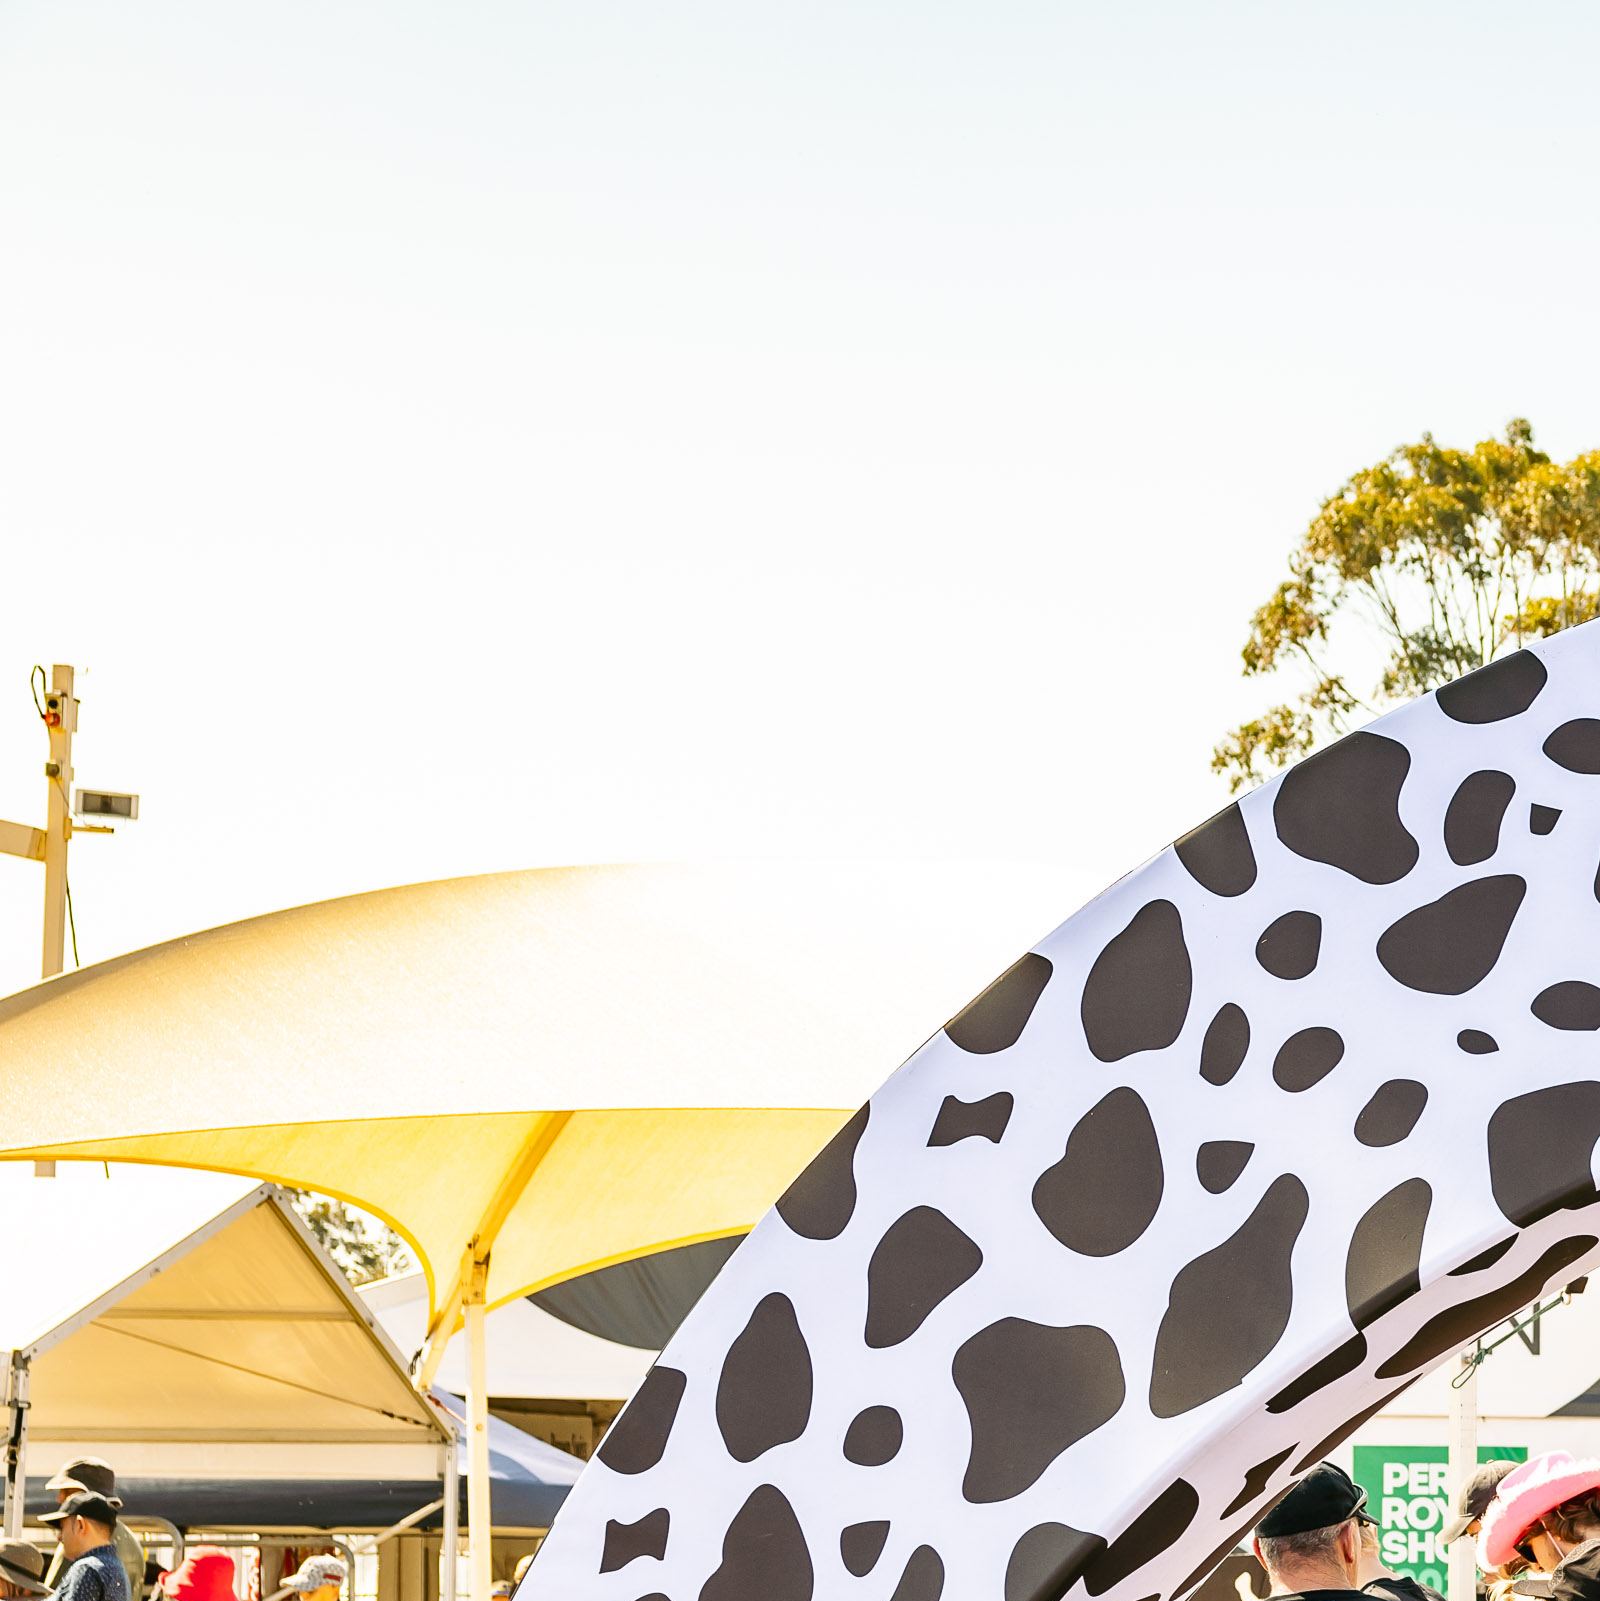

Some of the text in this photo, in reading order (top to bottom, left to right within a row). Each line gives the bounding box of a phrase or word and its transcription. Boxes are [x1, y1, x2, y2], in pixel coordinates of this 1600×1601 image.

[1383, 1462, 1449, 1495] PER
[1382, 1496, 1449, 1530] ROY
[1382, 1530, 1449, 1564] SH
